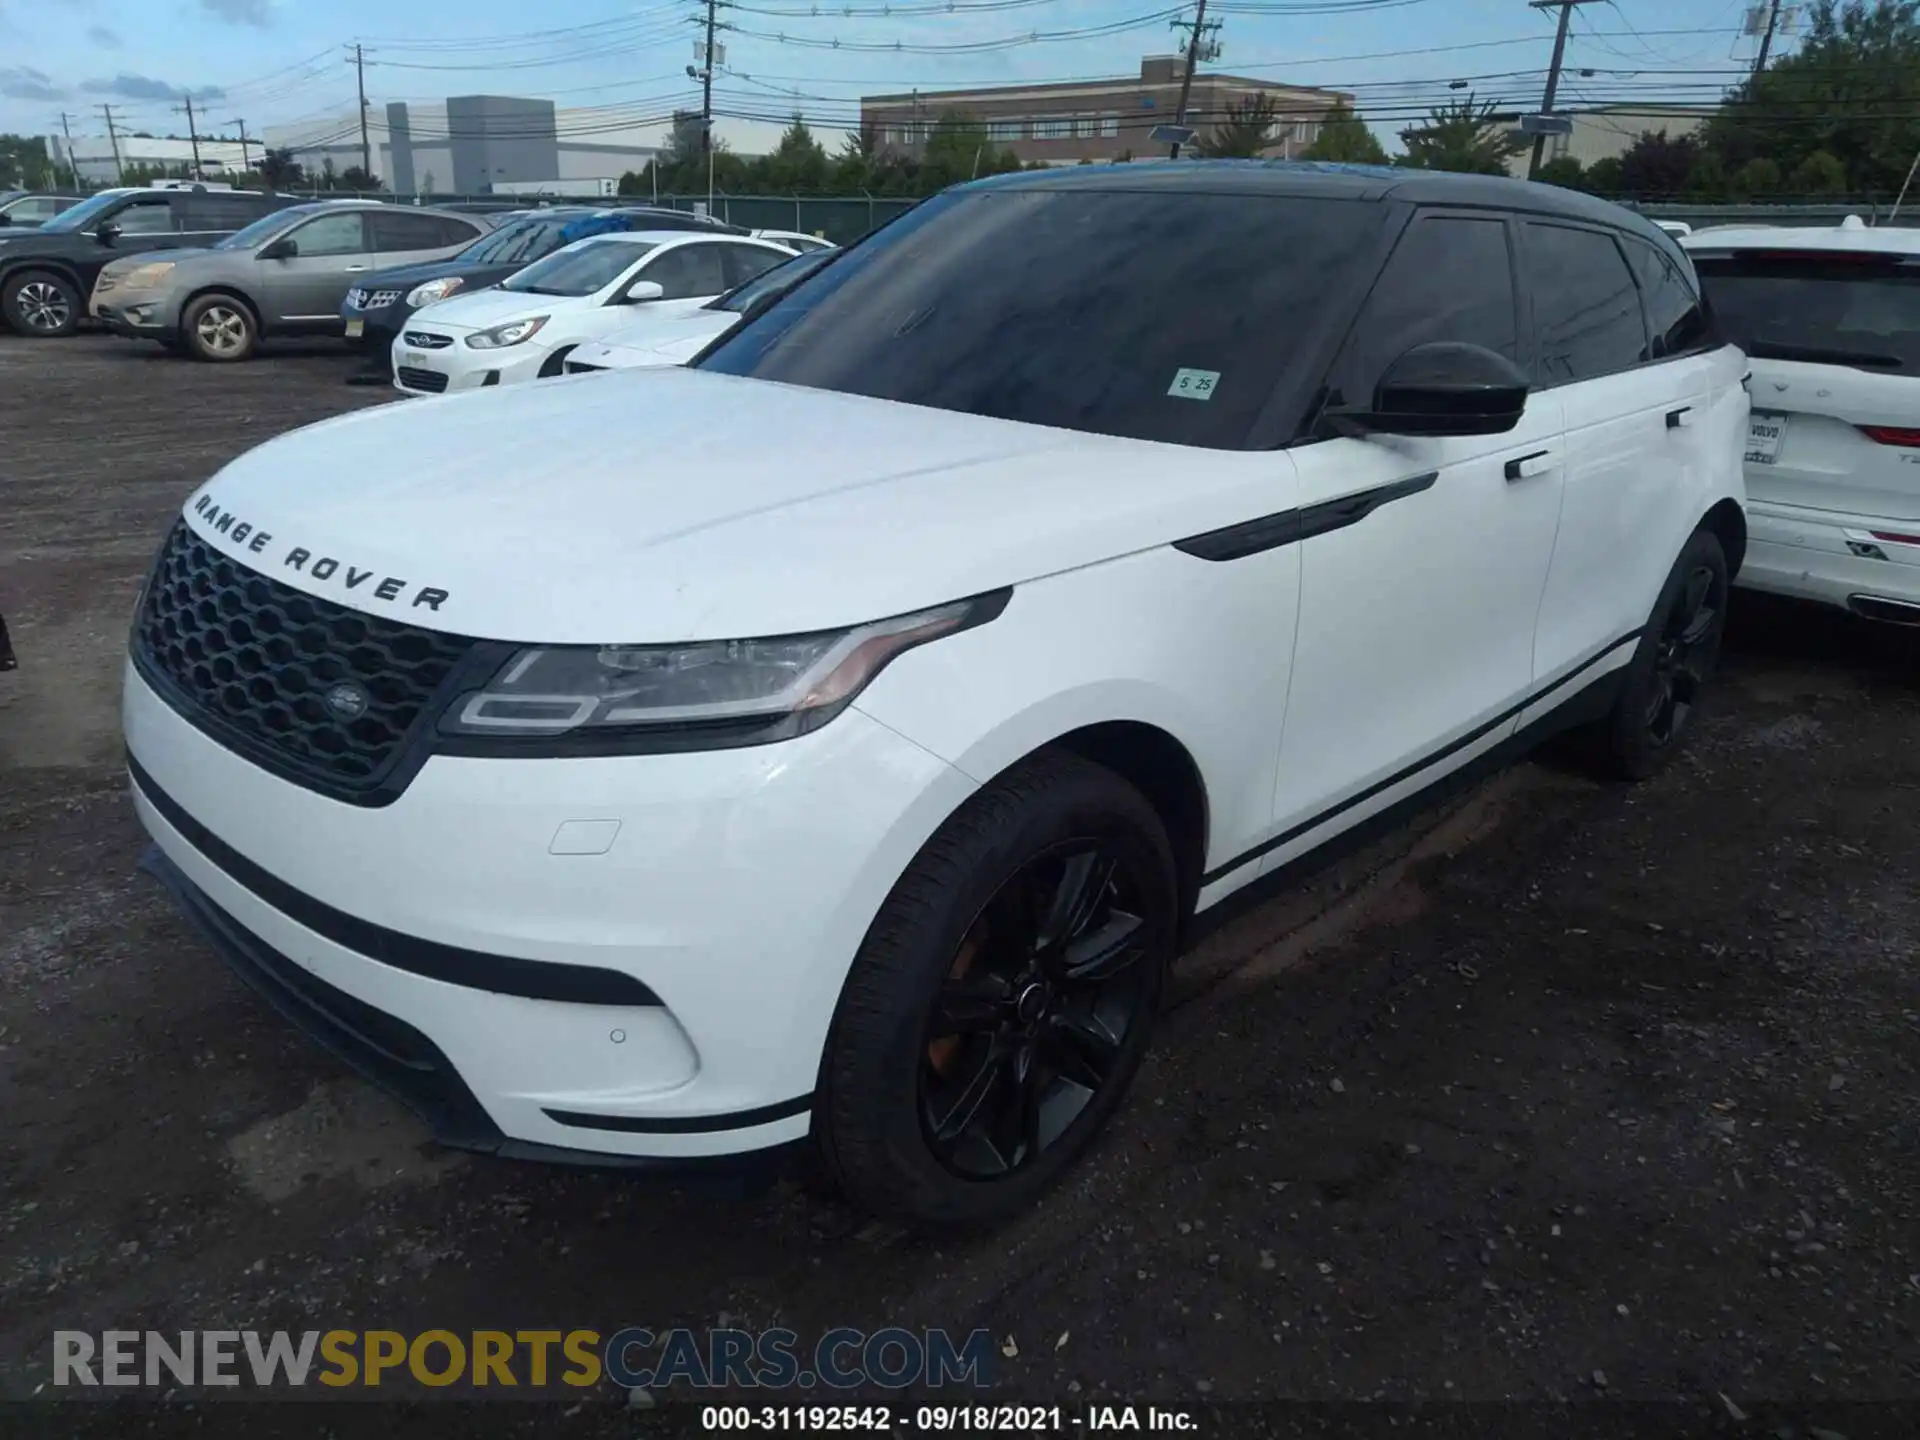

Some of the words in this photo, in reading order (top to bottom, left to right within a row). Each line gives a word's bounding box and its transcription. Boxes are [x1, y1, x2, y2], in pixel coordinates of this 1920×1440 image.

[1180, 376, 1190, 389] 5
[1195, 377, 1212, 391] 25
[195, 493, 272, 552] RANGE
[284, 546, 450, 611] ROVER
